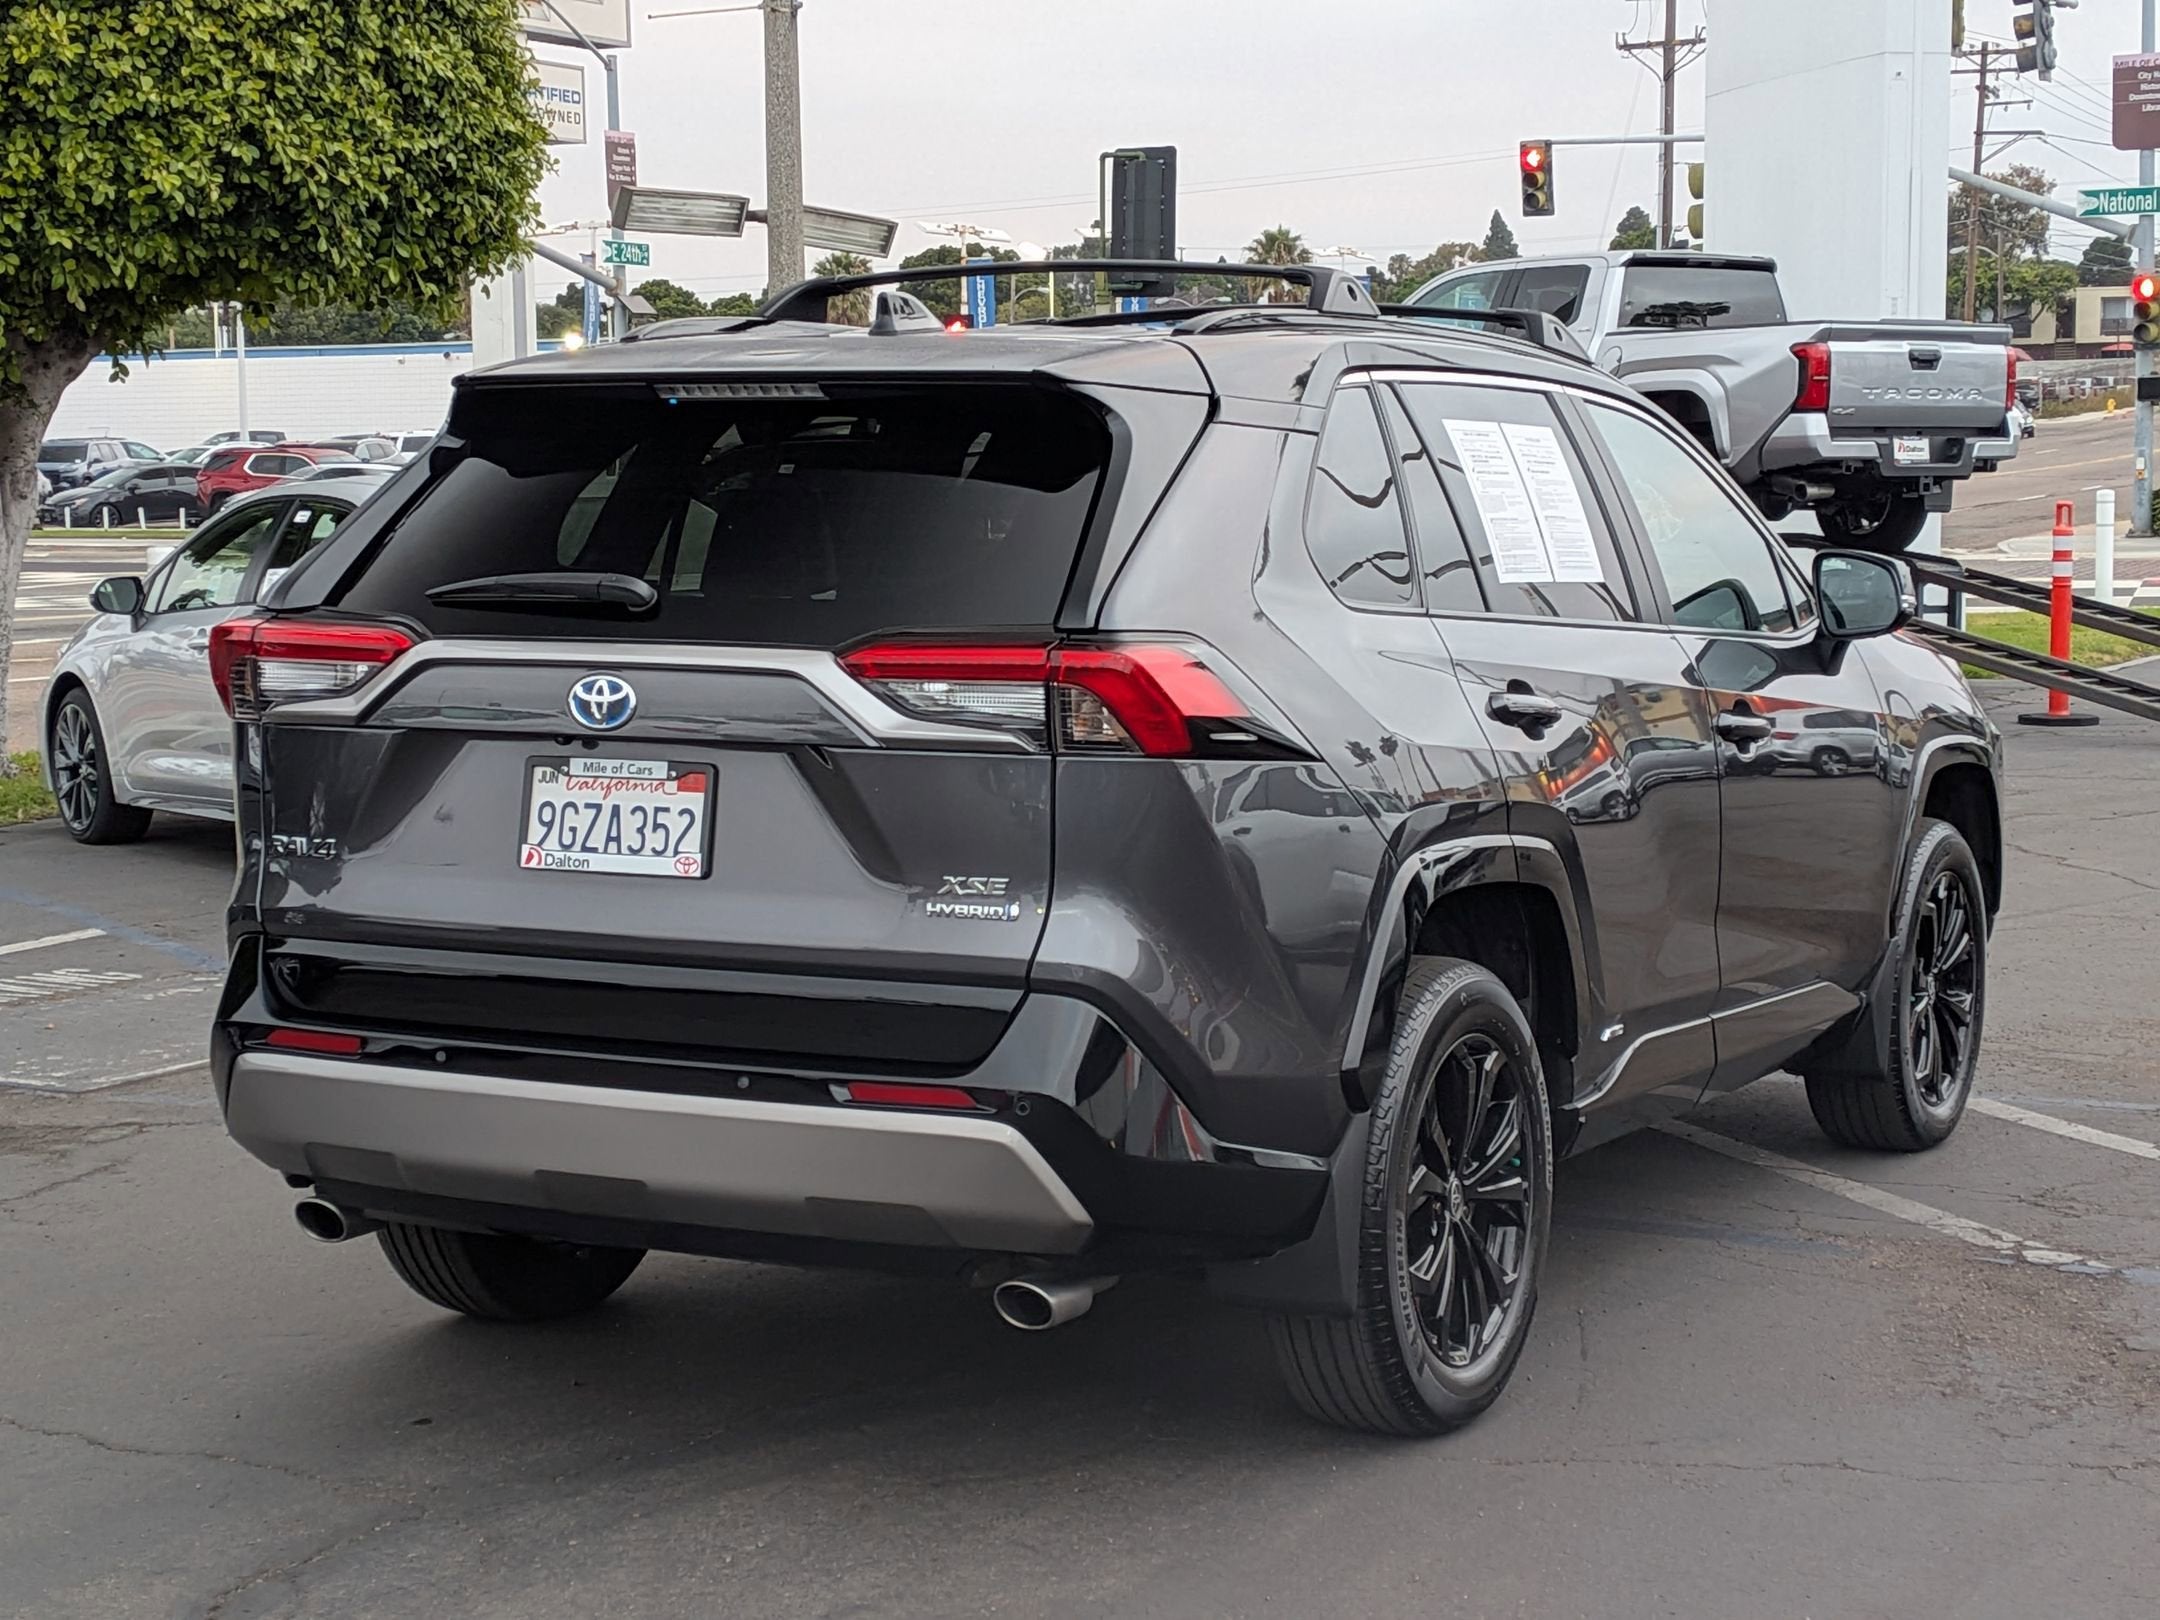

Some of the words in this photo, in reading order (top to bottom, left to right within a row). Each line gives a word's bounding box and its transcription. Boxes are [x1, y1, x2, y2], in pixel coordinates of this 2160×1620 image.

[2137, 71, 2152, 80] City
[2099, 189, 2157, 213] National
[611, 243, 620, 262] E
[620, 243, 642, 264] 24th
[1862, 387, 1983, 400] TACOMA
[538, 770, 559, 785] JUN
[583, 762, 606, 774] Mile
[611, 763, 624, 775] of
[627, 763, 653, 776] Cars
[537, 800, 696, 857] 9GZA352
[544, 851, 590, 869] Dalton
[936, 875, 1010, 895] XSE
[926, 902, 1006, 919] HYBRID
[1396, 1216, 1414, 1331] MICHELIN
